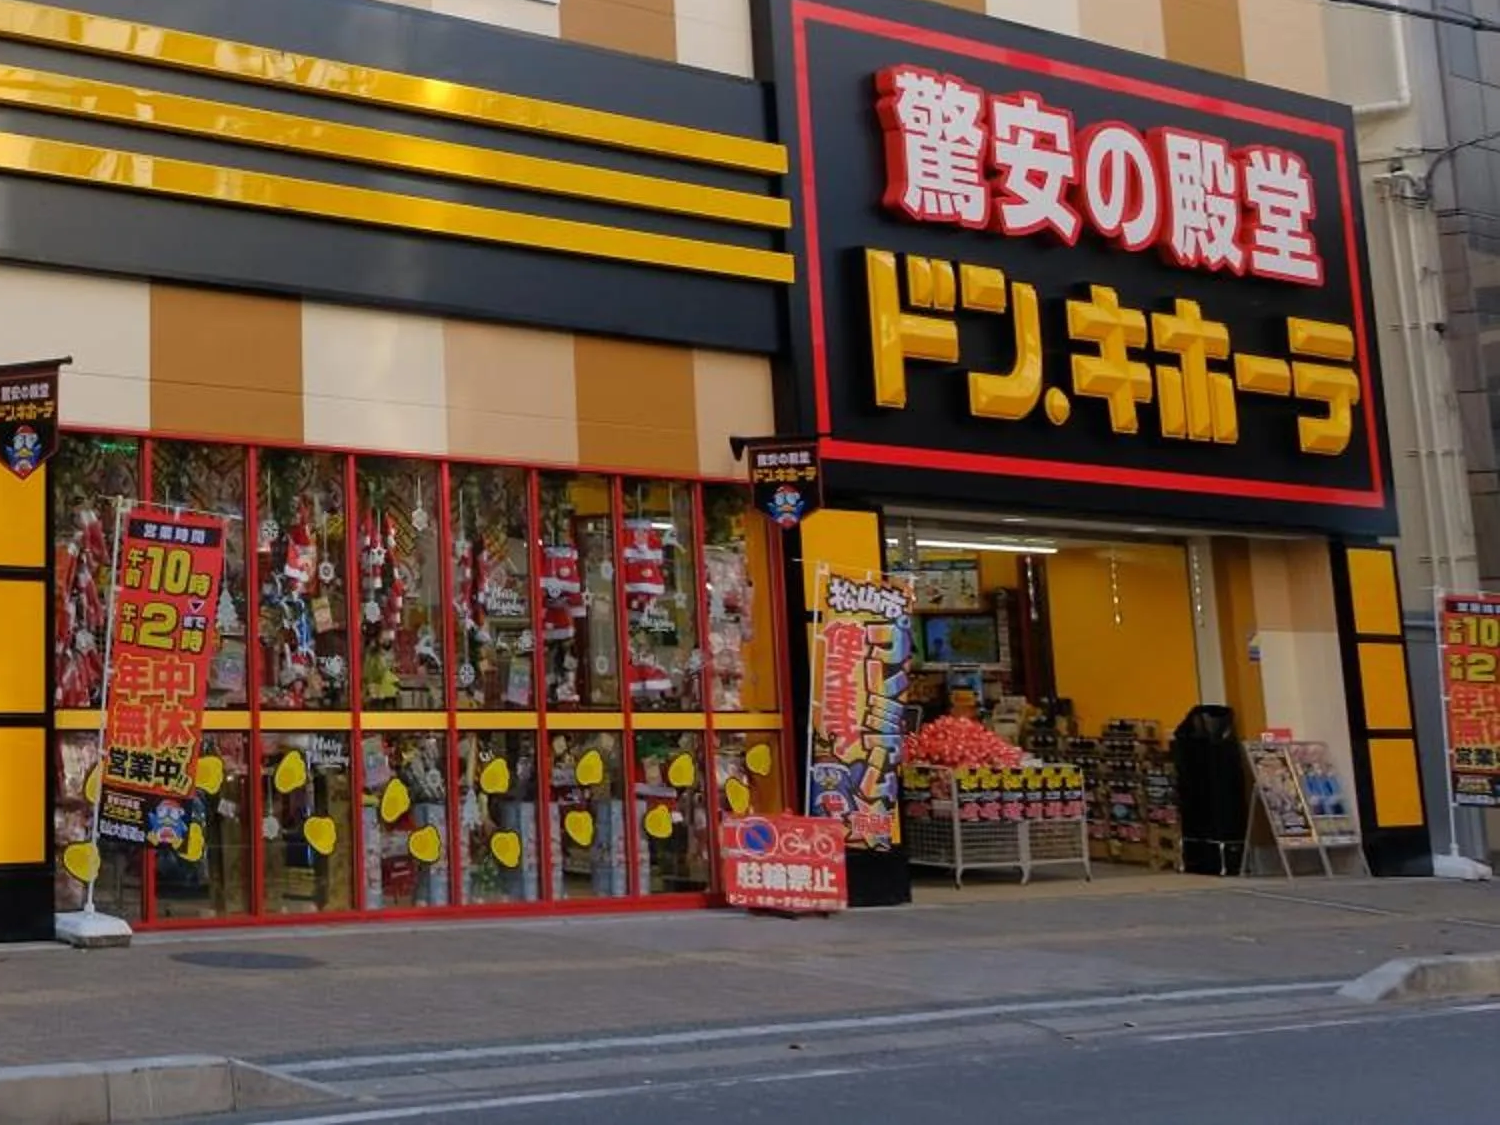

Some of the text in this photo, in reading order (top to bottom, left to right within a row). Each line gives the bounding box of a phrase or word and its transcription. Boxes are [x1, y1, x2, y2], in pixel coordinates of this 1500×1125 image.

[888, 68, 1323, 285] 驚安の殿堂
